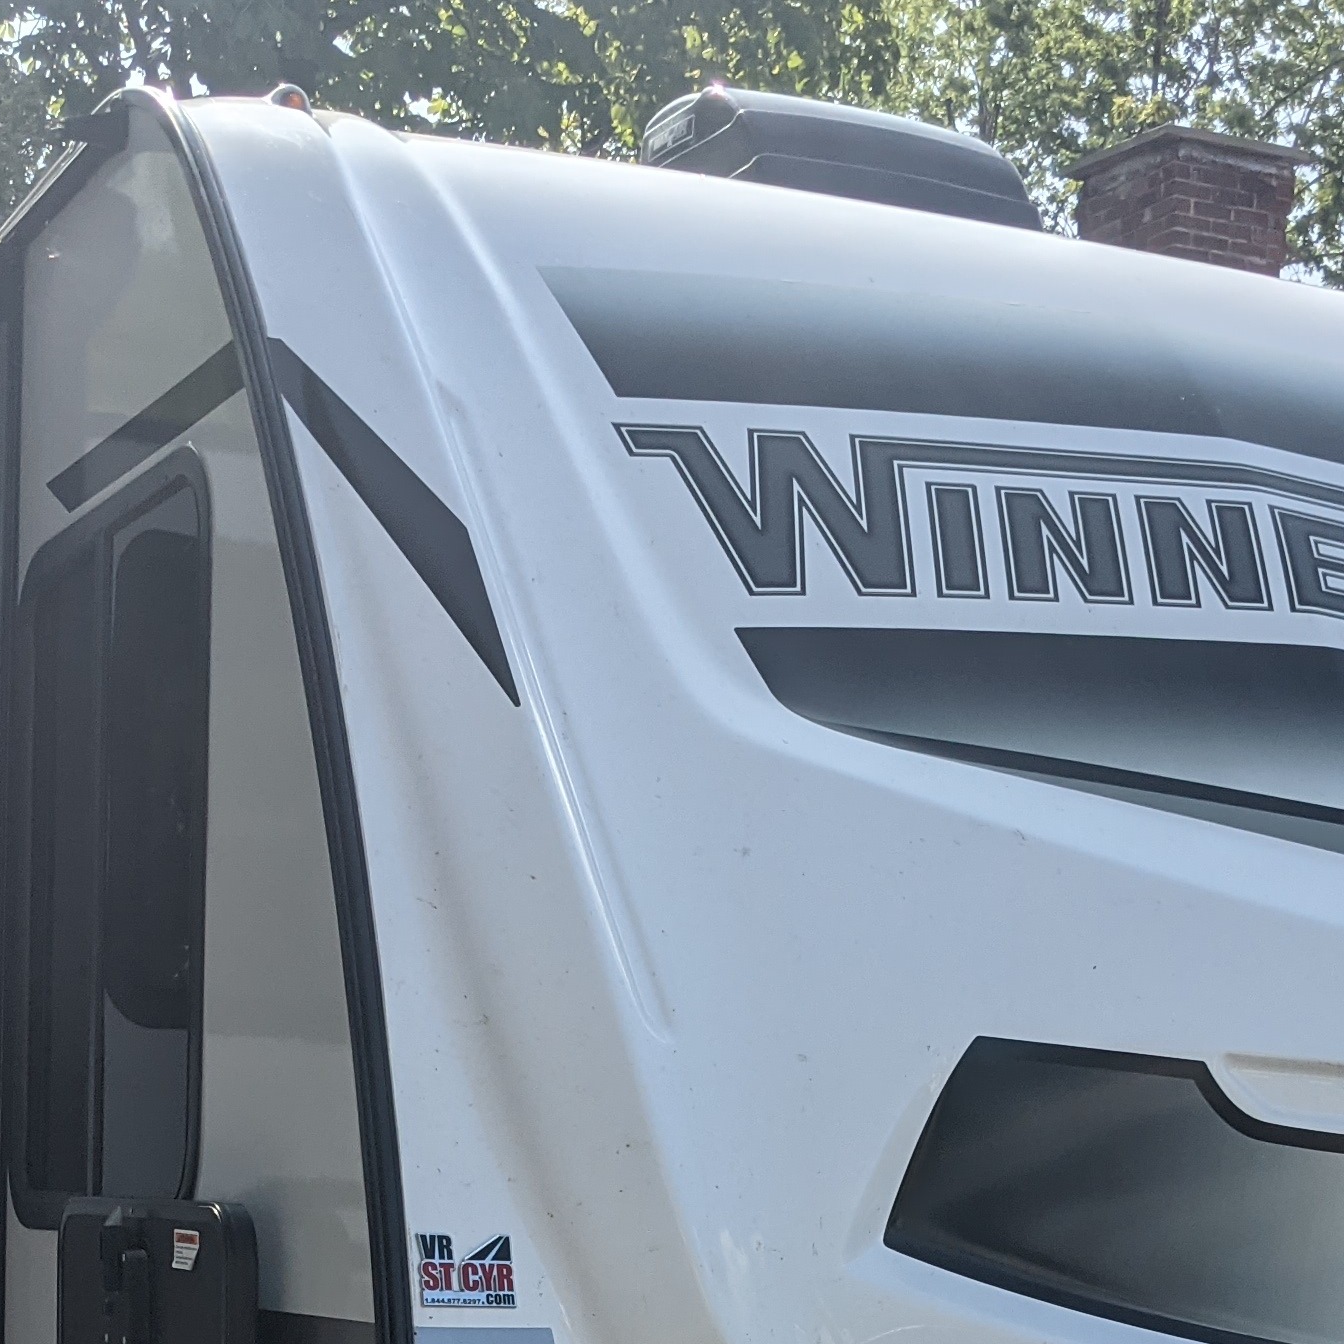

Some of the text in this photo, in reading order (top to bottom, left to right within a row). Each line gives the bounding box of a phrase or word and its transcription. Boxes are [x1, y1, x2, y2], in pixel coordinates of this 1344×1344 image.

[419, 1234, 454, 1261] VR
[422, 1261, 515, 1292] ST CYR
